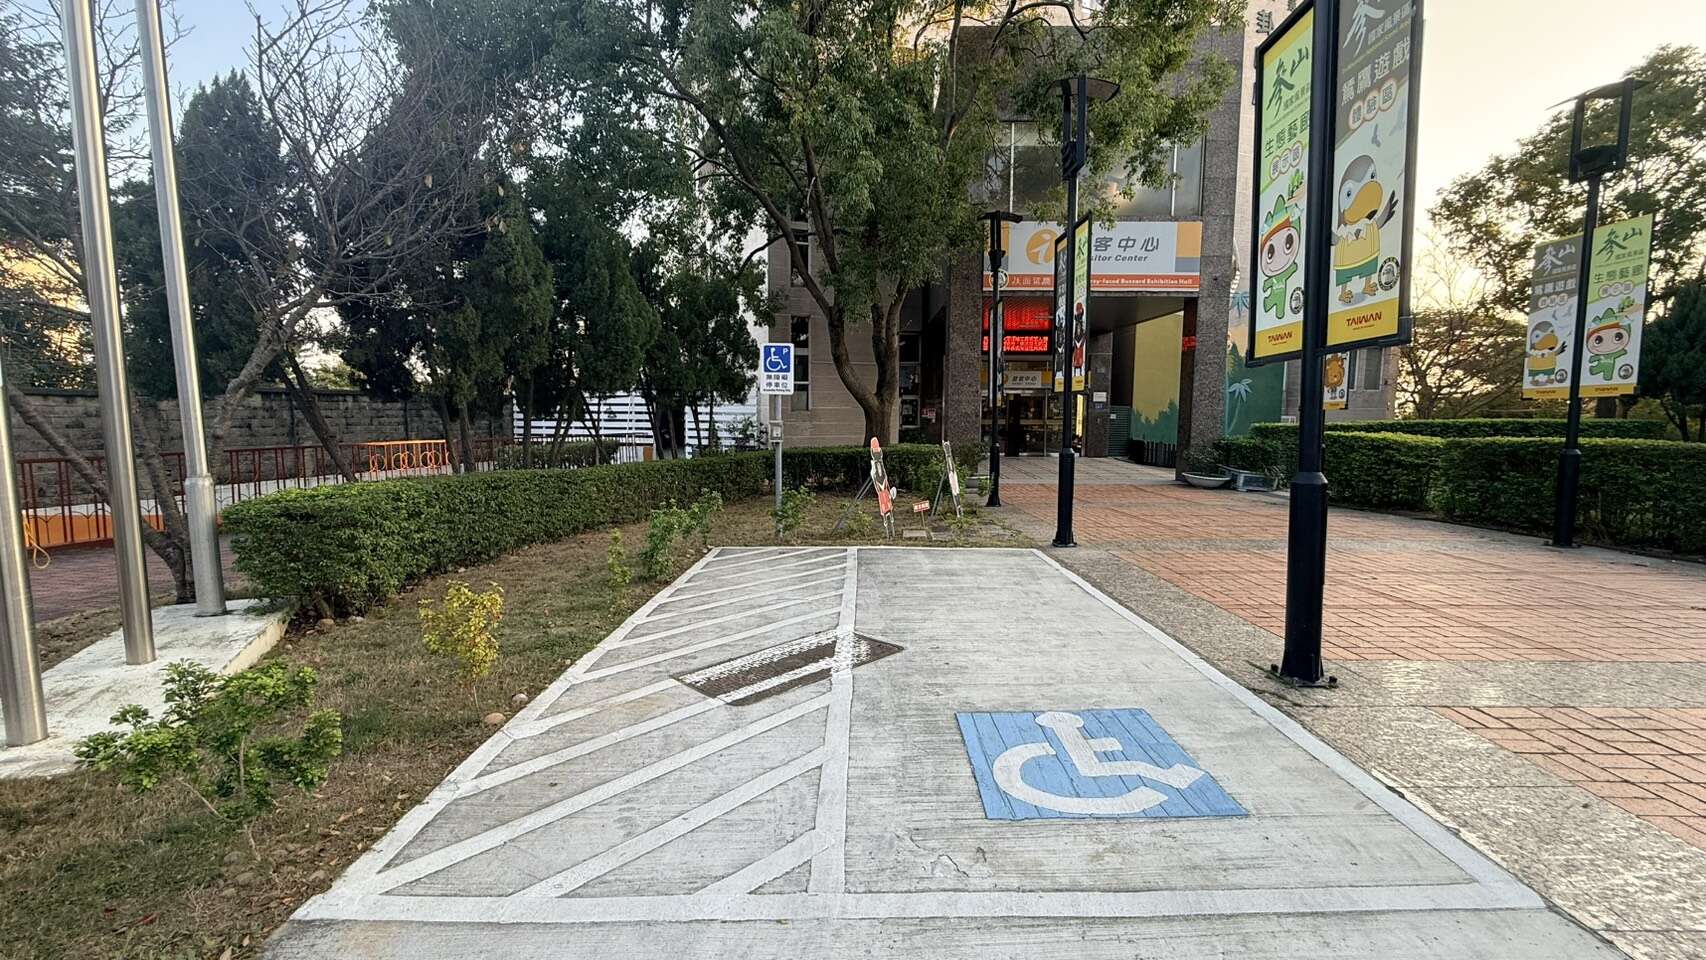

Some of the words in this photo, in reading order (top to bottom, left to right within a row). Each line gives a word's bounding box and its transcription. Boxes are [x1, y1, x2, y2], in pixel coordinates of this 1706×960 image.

[1114, 254, 1148, 262] Center
[1346, 311, 1382, 327] TAIWAN
[1268, 330, 1293, 343] TAIWAN
